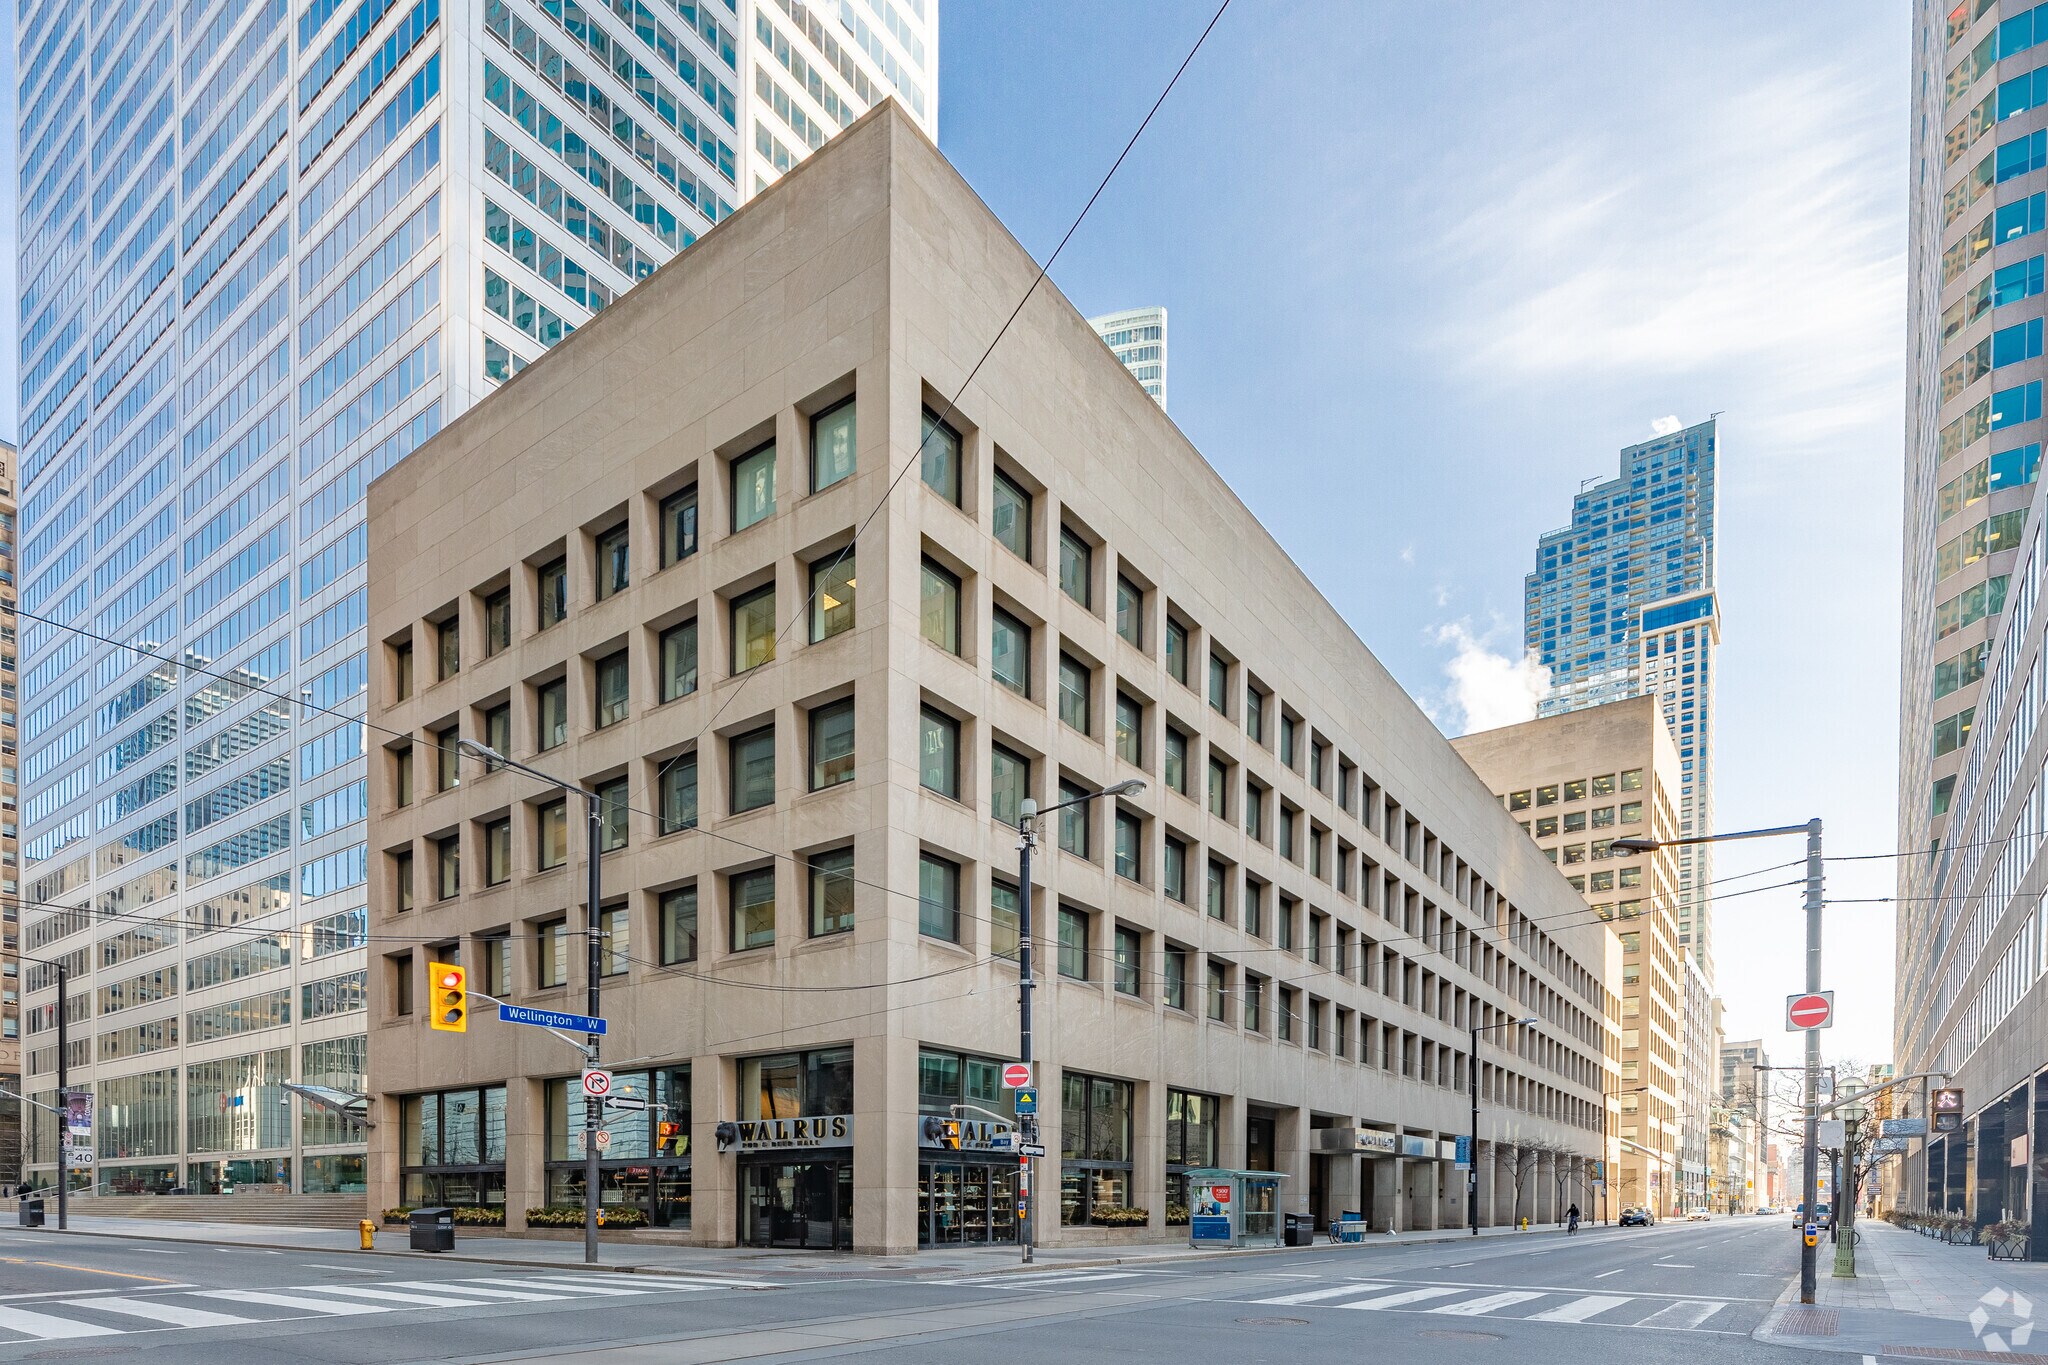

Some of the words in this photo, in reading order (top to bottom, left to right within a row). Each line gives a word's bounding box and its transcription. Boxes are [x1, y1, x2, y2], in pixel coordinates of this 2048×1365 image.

[508, 1007, 573, 1026] Wellington
[587, 1018, 598, 1029] W
[737, 1117, 847, 1141] WALRUS
[75, 1153, 93, 1163] 40
